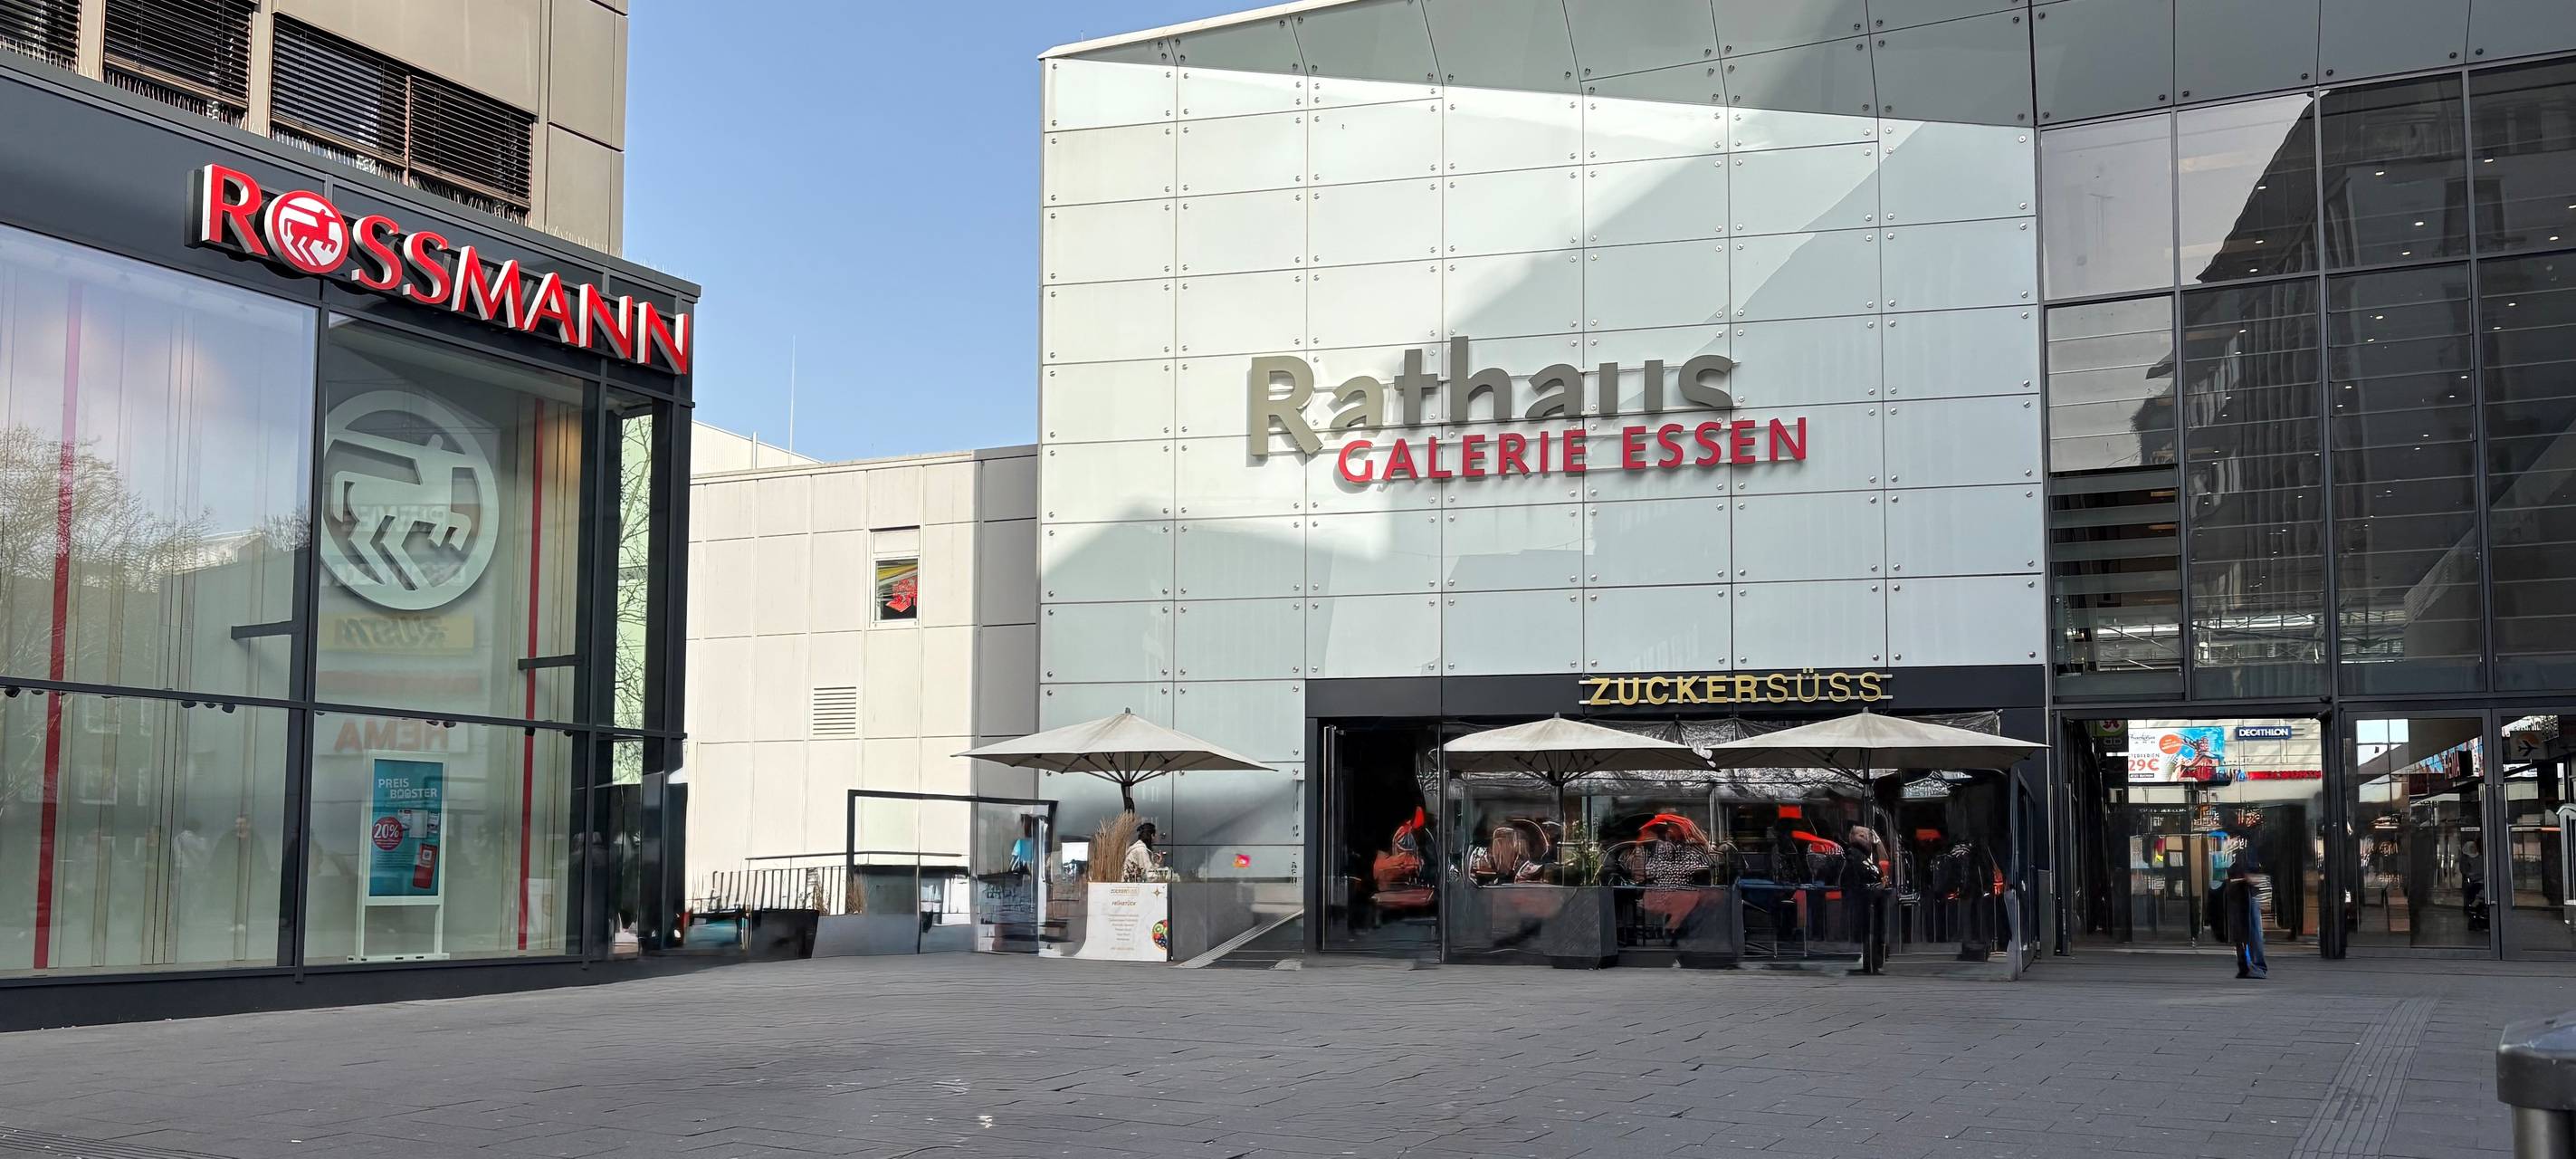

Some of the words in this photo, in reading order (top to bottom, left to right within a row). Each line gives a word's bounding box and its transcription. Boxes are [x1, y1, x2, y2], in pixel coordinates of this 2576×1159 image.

[201, 163, 689, 376] ROSSMANN
[1249, 336, 1734, 456] Rathaus
[1337, 427, 1588, 484] GALERIE
[1621, 417, 1808, 472] ESSEN
[1589, 667, 1883, 706] ZUCKERSÜSS
[2238, 728, 2289, 737] DECATHLON
[377, 778, 410, 789] PREIS
[390, 788, 438, 799] BOOSTER
[374, 823, 400, 839] 20%
